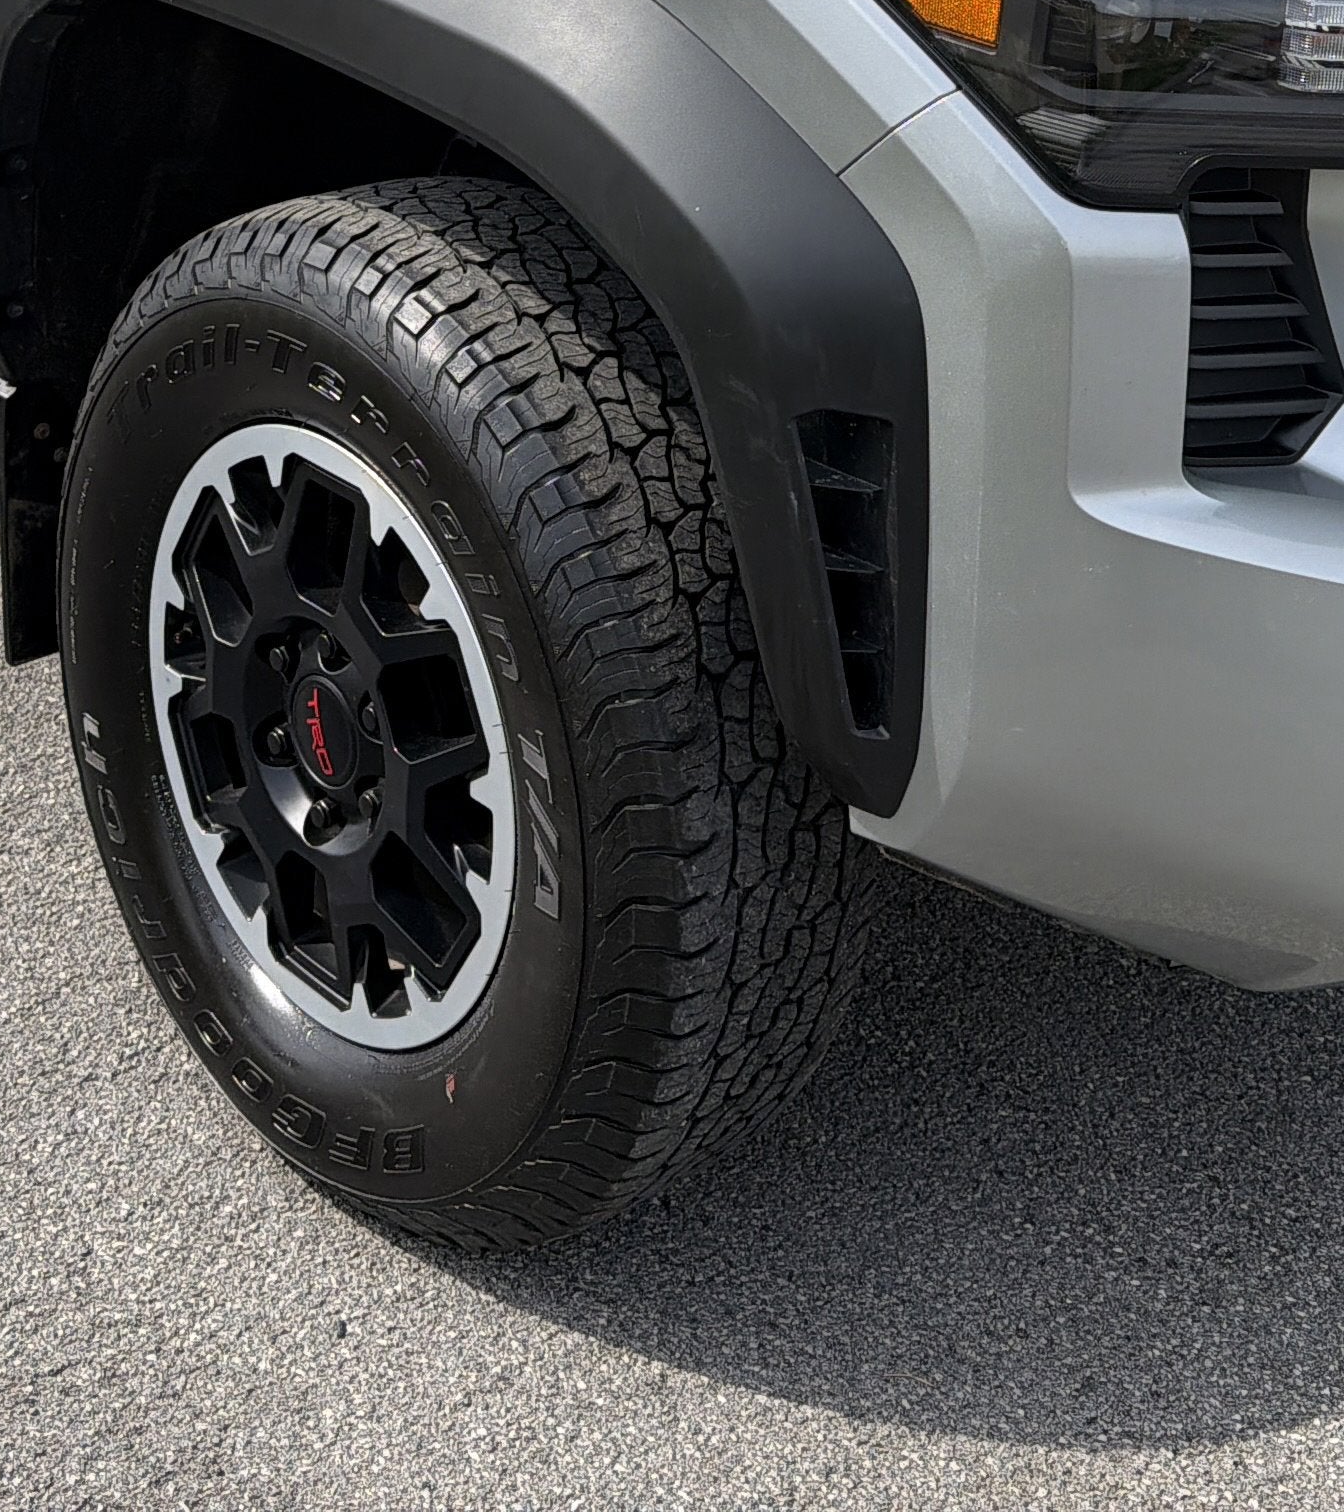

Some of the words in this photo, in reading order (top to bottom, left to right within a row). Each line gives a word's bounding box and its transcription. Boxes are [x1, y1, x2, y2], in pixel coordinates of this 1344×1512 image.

[305, 687, 335, 777] TRD
[517, 729, 561, 920] T/A
[82, 709, 425, 1175] BFGoodrich
